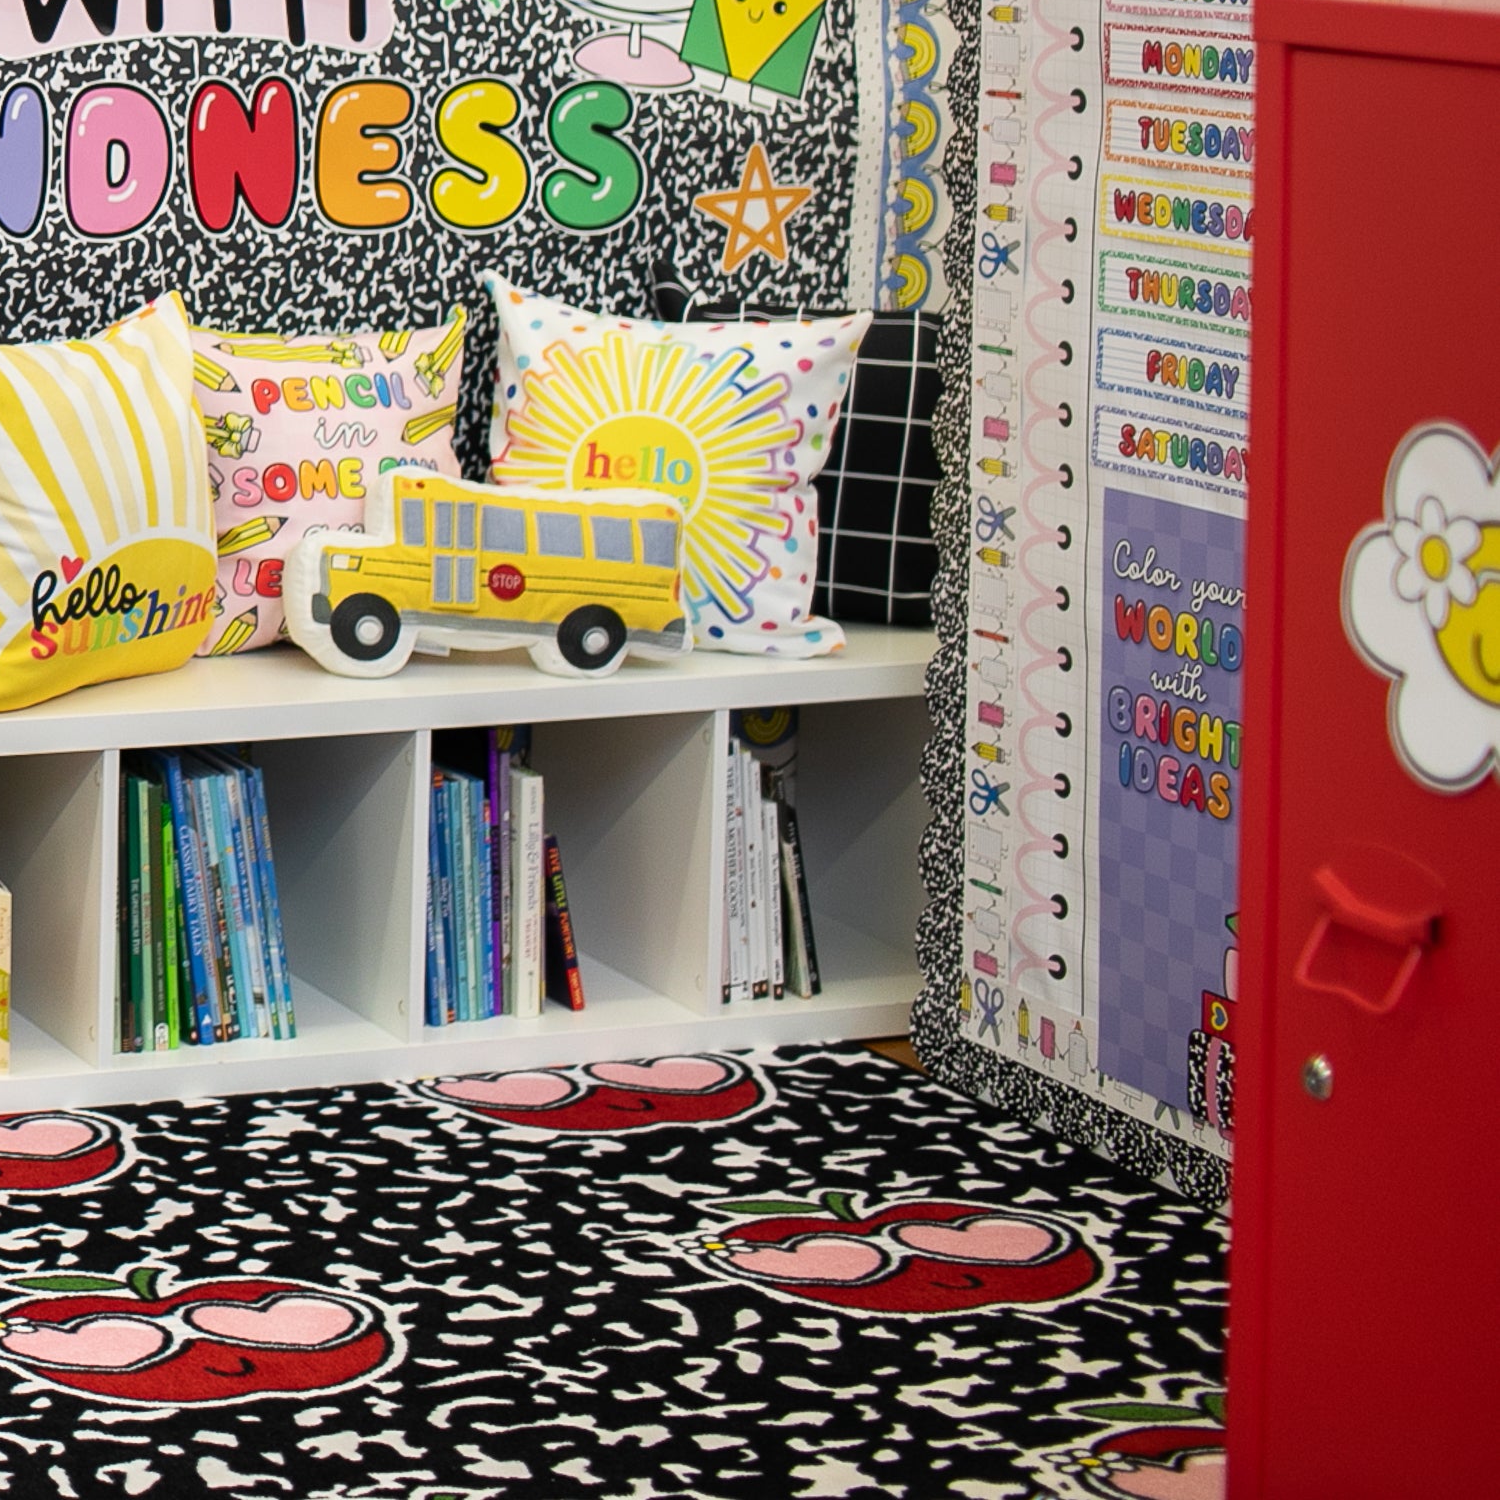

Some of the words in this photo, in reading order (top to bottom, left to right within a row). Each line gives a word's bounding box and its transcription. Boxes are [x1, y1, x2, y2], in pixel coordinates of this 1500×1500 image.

[1142, 40, 1254, 84] MONDAY
[1138, 116, 1255, 162] TUESDAY
[1126, 267, 1254, 321] THURSDA
[251, 372, 412, 414] PENCIL
[1146, 350, 1239, 399] FRIDAY
[314, 417, 377, 449] in
[233, 457, 366, 508] SOME
[585, 442, 692, 485] hello
[32, 564, 147, 631] hello
[492, 573, 521, 591] STOP
[1112, 539, 1180, 591] Color
[1192, 577, 1247, 612] your
[31, 585, 216, 660] sunshine
[1113, 594, 1244, 672] WORLD
[1150, 663, 1207, 703] with
[1107, 685, 1243, 770] BRIGHT
[1117, 741, 1231, 820] IDEAS
[549, 848, 562, 873] FIVE
